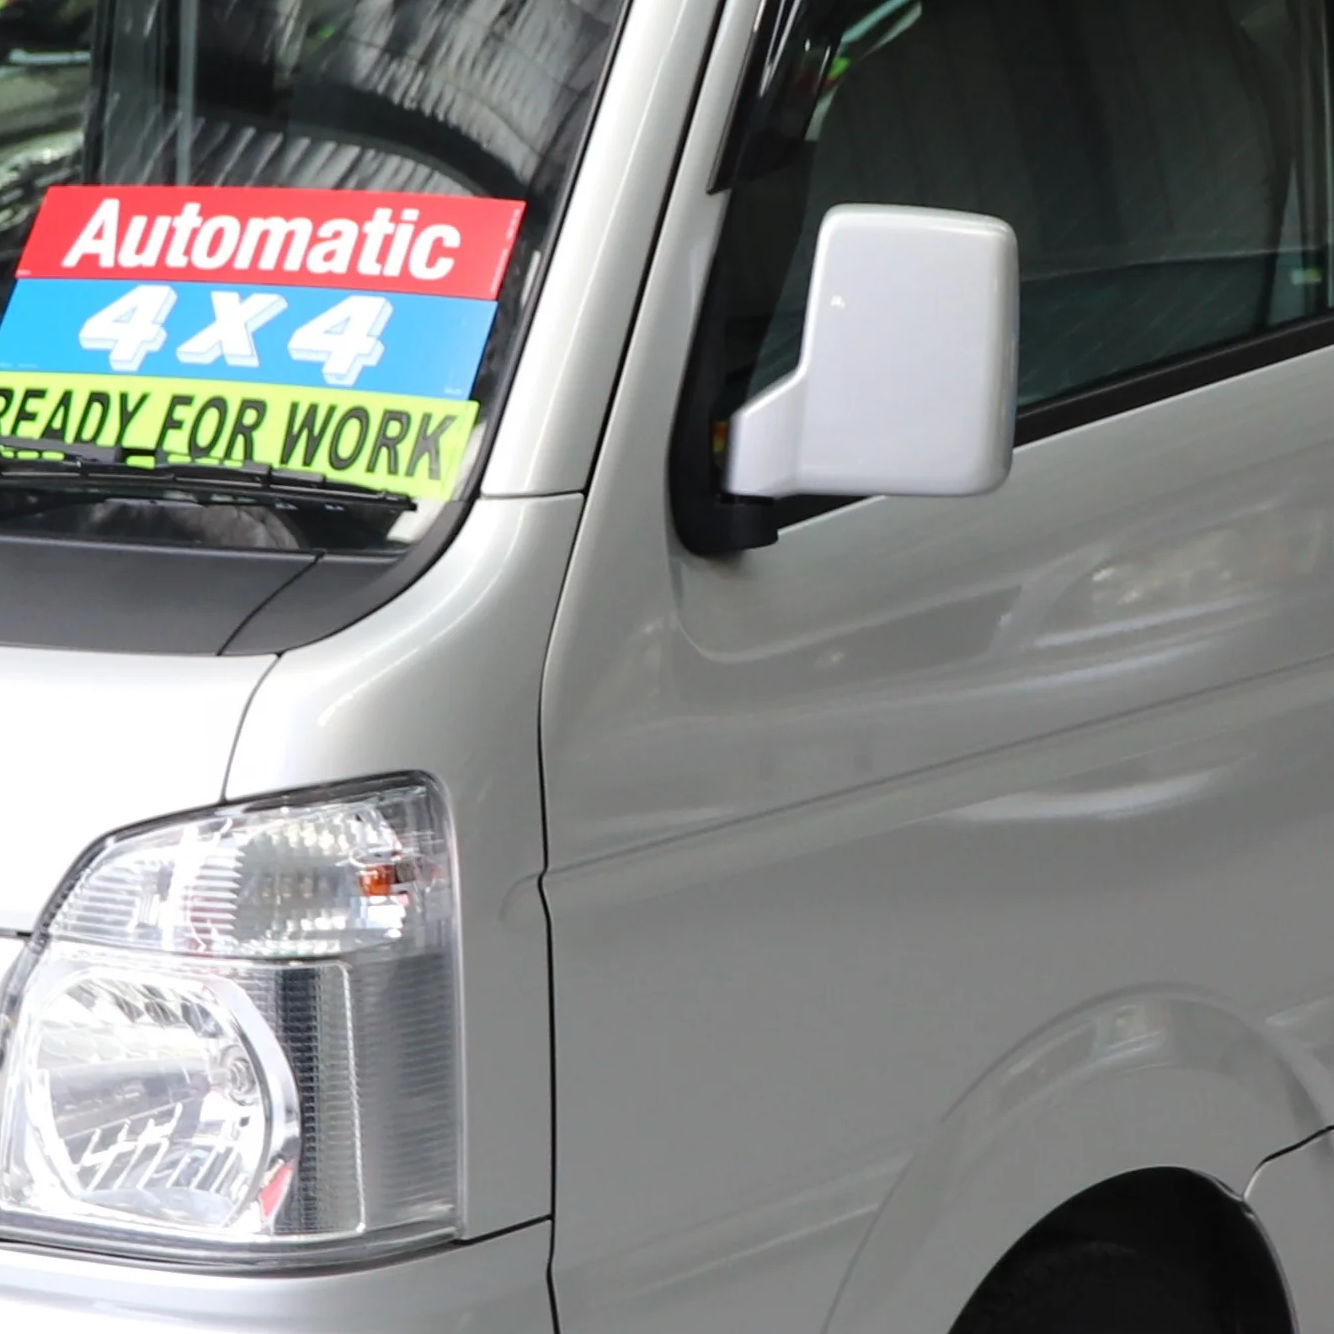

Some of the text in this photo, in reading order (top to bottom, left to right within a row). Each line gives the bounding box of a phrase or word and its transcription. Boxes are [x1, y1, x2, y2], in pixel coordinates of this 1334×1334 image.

[62, 198, 461, 281] Automatic
[157, 394, 267, 463] FOR
[280, 401, 458, 480] WORK
